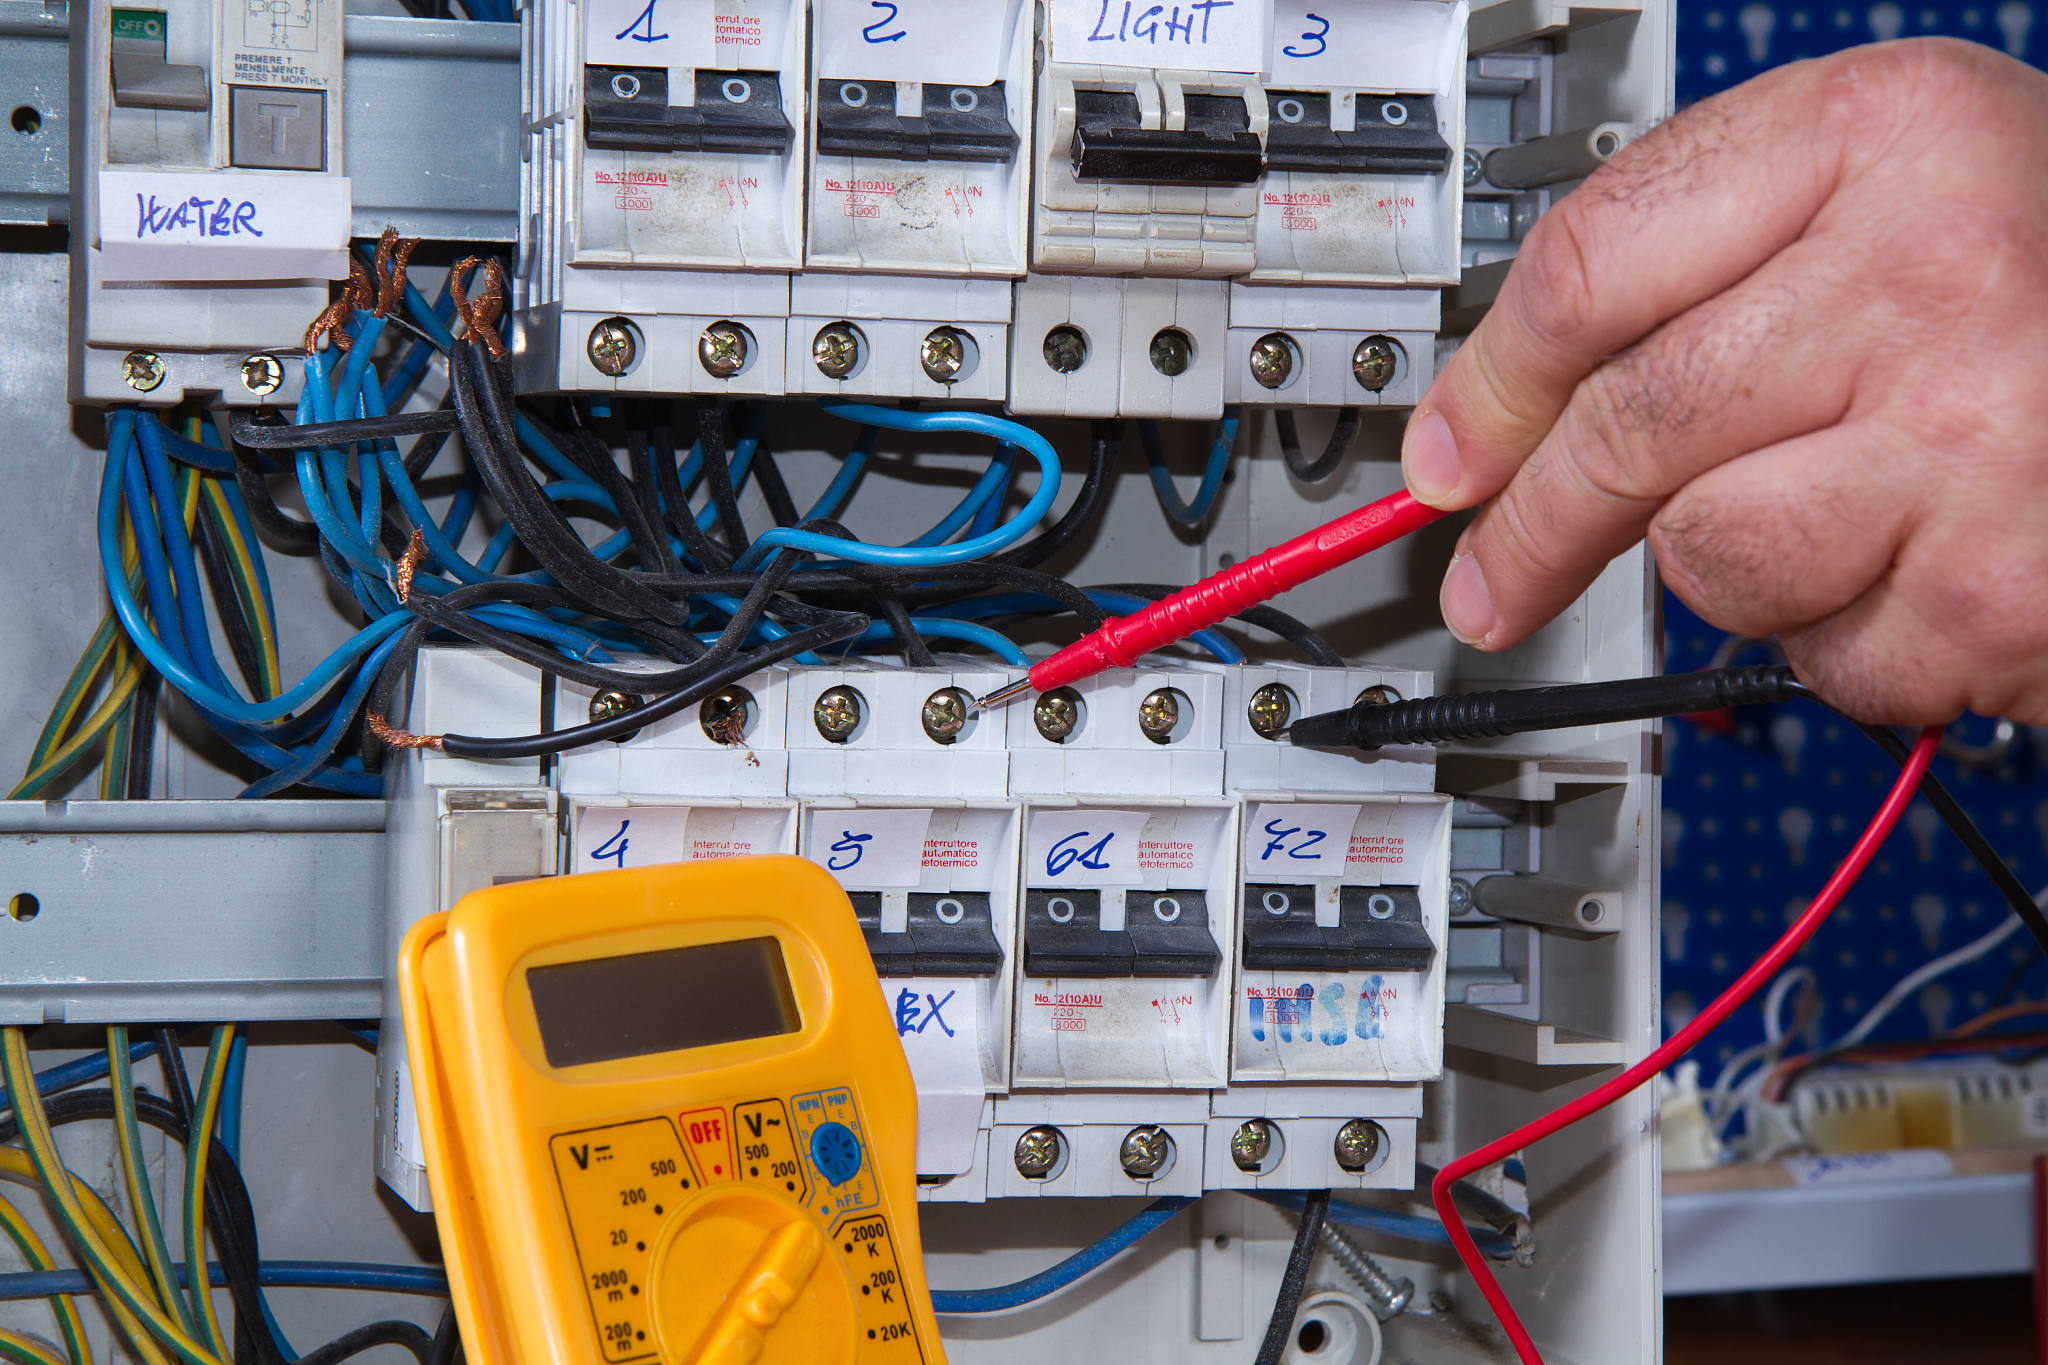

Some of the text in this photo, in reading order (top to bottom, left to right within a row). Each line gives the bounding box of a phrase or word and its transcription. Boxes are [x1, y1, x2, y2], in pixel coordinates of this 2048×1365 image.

[119, 20, 143, 31] OFF
[715, 15, 761, 25] errutore
[863, 1, 906, 43] 2
[1087, 0, 1234, 45] LIGHT
[715, 24, 761, 35] tomatico
[1283, 13, 1330, 58] 3
[715, 34, 761, 45] otermico
[234, 53, 292, 65] PREMERE T
[234, 63, 306, 75] MENSILMENTE
[234, 72, 329, 86] PRESS T MONTHLY
[257, 102, 300, 155] T
[595, 171, 613, 181] No.
[825, 178, 843, 189] No.
[1264, 192, 1280, 202] No.
[136, 193, 263, 239] WATER
[1323, 506, 1388, 547] MAX 600V
[591, 819, 630, 868] 4
[693, 840, 751, 850] Interrutore
[924, 839, 978, 849] nterruttore
[1350, 835, 1404, 845] Interrutore
[827, 830, 873, 871] 5
[1138, 850, 1194, 860] automatico
[1349, 845, 1404, 854] automatico
[921, 858, 978, 868] etotermico
[1139, 860, 1194, 869] etotermico
[1345, 855, 1403, 864] netotermico
[1034, 993, 1050, 1003] No.
[1247, 987, 1263, 997] No.
[797, 1098, 820, 1112] NPN
[827, 1093, 847, 1107] PNP
[807, 1114, 814, 1124] E
[837, 1109, 844, 1119] E
[690, 1119, 721, 1144] OFF
[745, 1143, 769, 1160] 500
[651, 1158, 676, 1177] 500
[771, 1160, 796, 1178] 200
[620, 1187, 646, 1206] 200
[835, 1193, 863, 1209] hFE
[609, 1229, 627, 1246] 20
[851, 1222, 884, 1243] 2000
[867, 1242, 880, 1258] K
[591, 1268, 628, 1290] 2000
[870, 1269, 895, 1288] 200
[608, 1289, 623, 1303] m
[881, 1288, 894, 1304] K
[605, 1321, 632, 1342] 200
[880, 1321, 912, 1342] 20K
[617, 1339, 632, 1352] m
